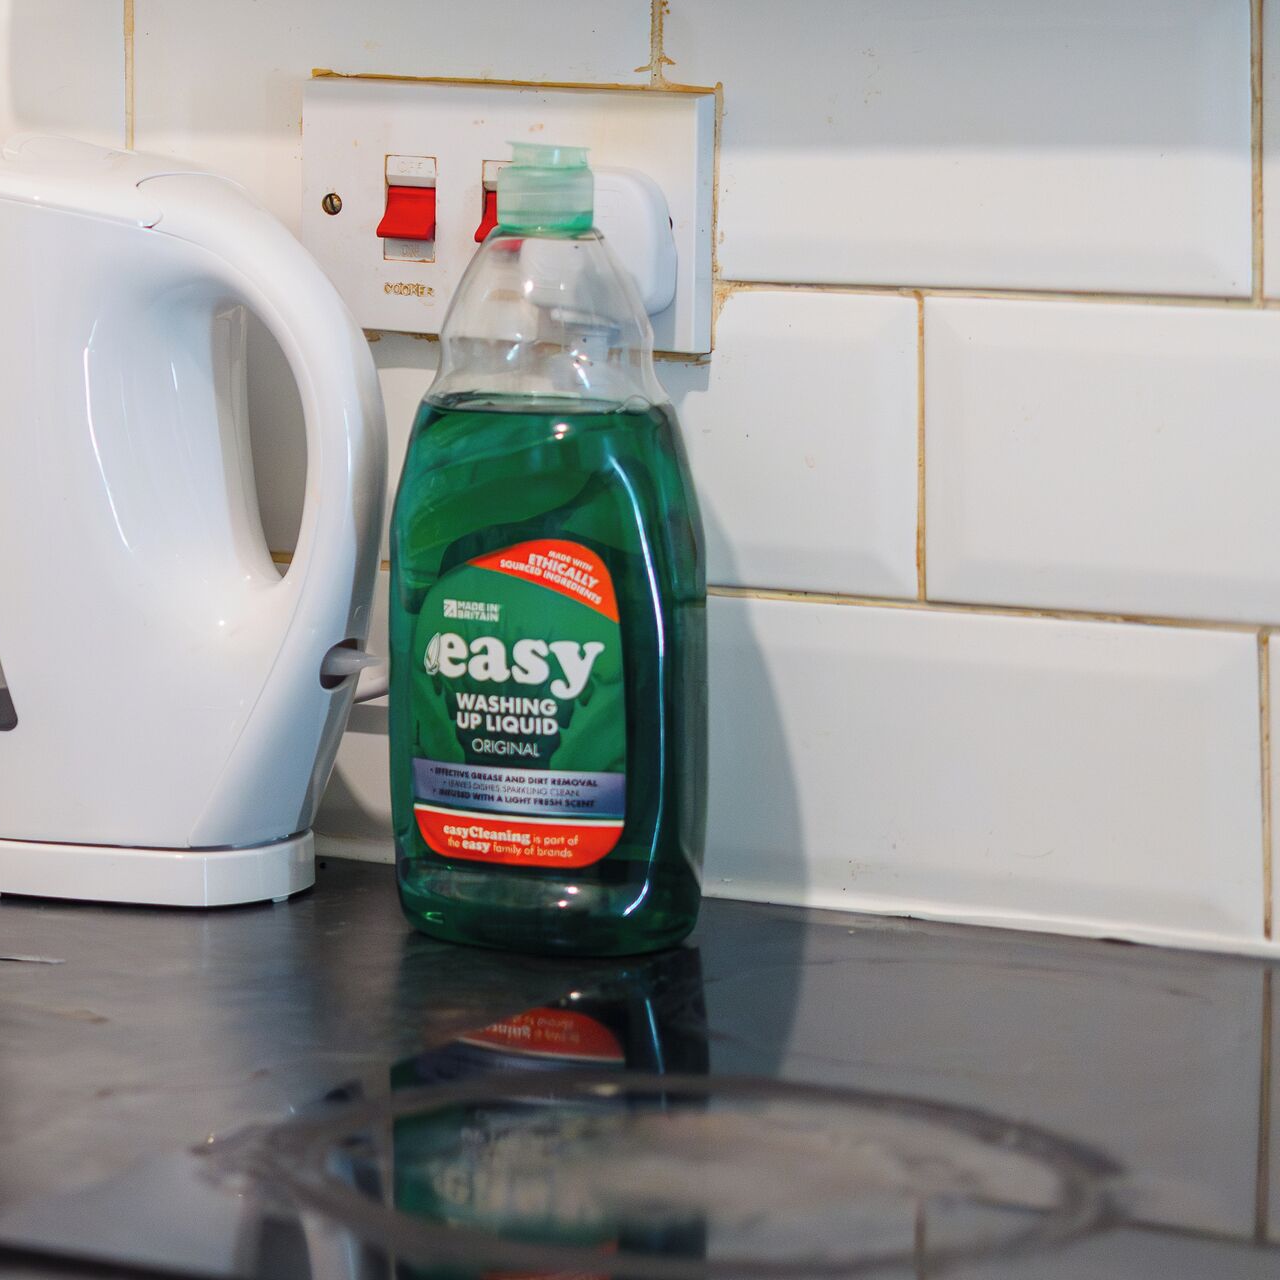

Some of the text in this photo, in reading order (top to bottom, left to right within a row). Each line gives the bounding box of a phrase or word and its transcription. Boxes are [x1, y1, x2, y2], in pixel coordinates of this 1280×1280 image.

[383, 282, 435, 298] COOKER
[528, 553, 599, 588] ETHICALLY
[548, 550, 593, 572] MADE WITH
[500, 559, 602, 605] SOURCED INGREDIENTS
[457, 601, 499, 612] MADE IN
[457, 610, 499, 622] BRITAIN
[437, 632, 605, 700] easy
[456, 692, 558, 716] WASHING
[456, 712, 558, 736] UP LIQUID
[472, 738, 540, 757] ORIGINAL
[435, 767, 598, 787] EFFECTIVE GREASE AND DIRT REMOVAL
[472, 792, 495, 802] WITH
[505, 796, 531, 805] LIGHT
[534, 797, 562, 807] FRESH
[565, 799, 595, 808] SCENT
[503, 785, 547, 796] SPARKLING
[443, 825, 579, 846] easyCleaning is part of
[448, 838, 573, 858] the easy family of brands
